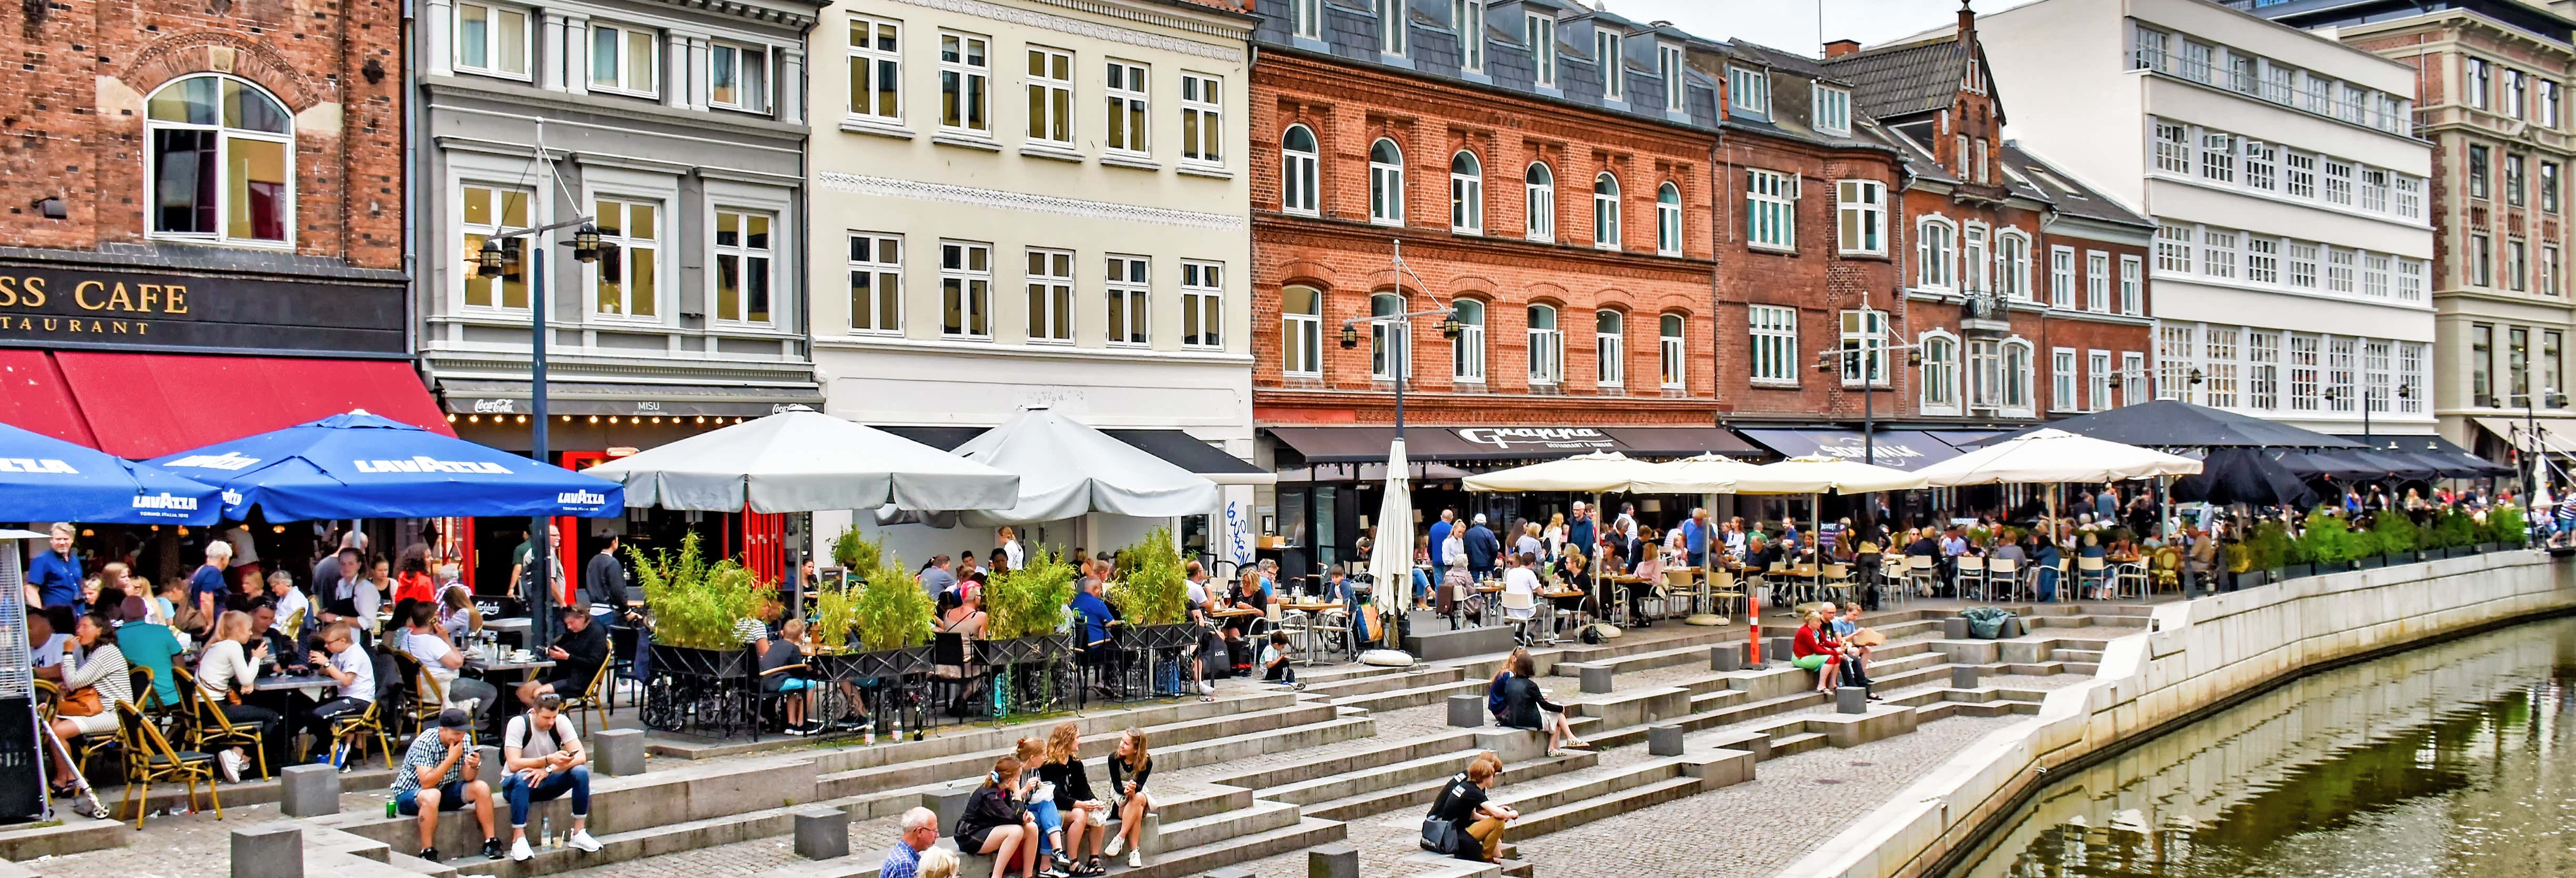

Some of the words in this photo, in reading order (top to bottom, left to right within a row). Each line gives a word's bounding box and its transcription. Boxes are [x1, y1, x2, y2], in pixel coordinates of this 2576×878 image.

[75, 281, 188, 314] CAFE
[475, 399, 513, 413] Coca-Cola
[638, 402, 660, 410] MISU
[353, 456, 514, 474] LAVAZZA
[133, 493, 197, 510] LAVAZZA
[557, 489, 605, 504] LAVAZZA
[475, 601, 500, 616] Carlsberg
